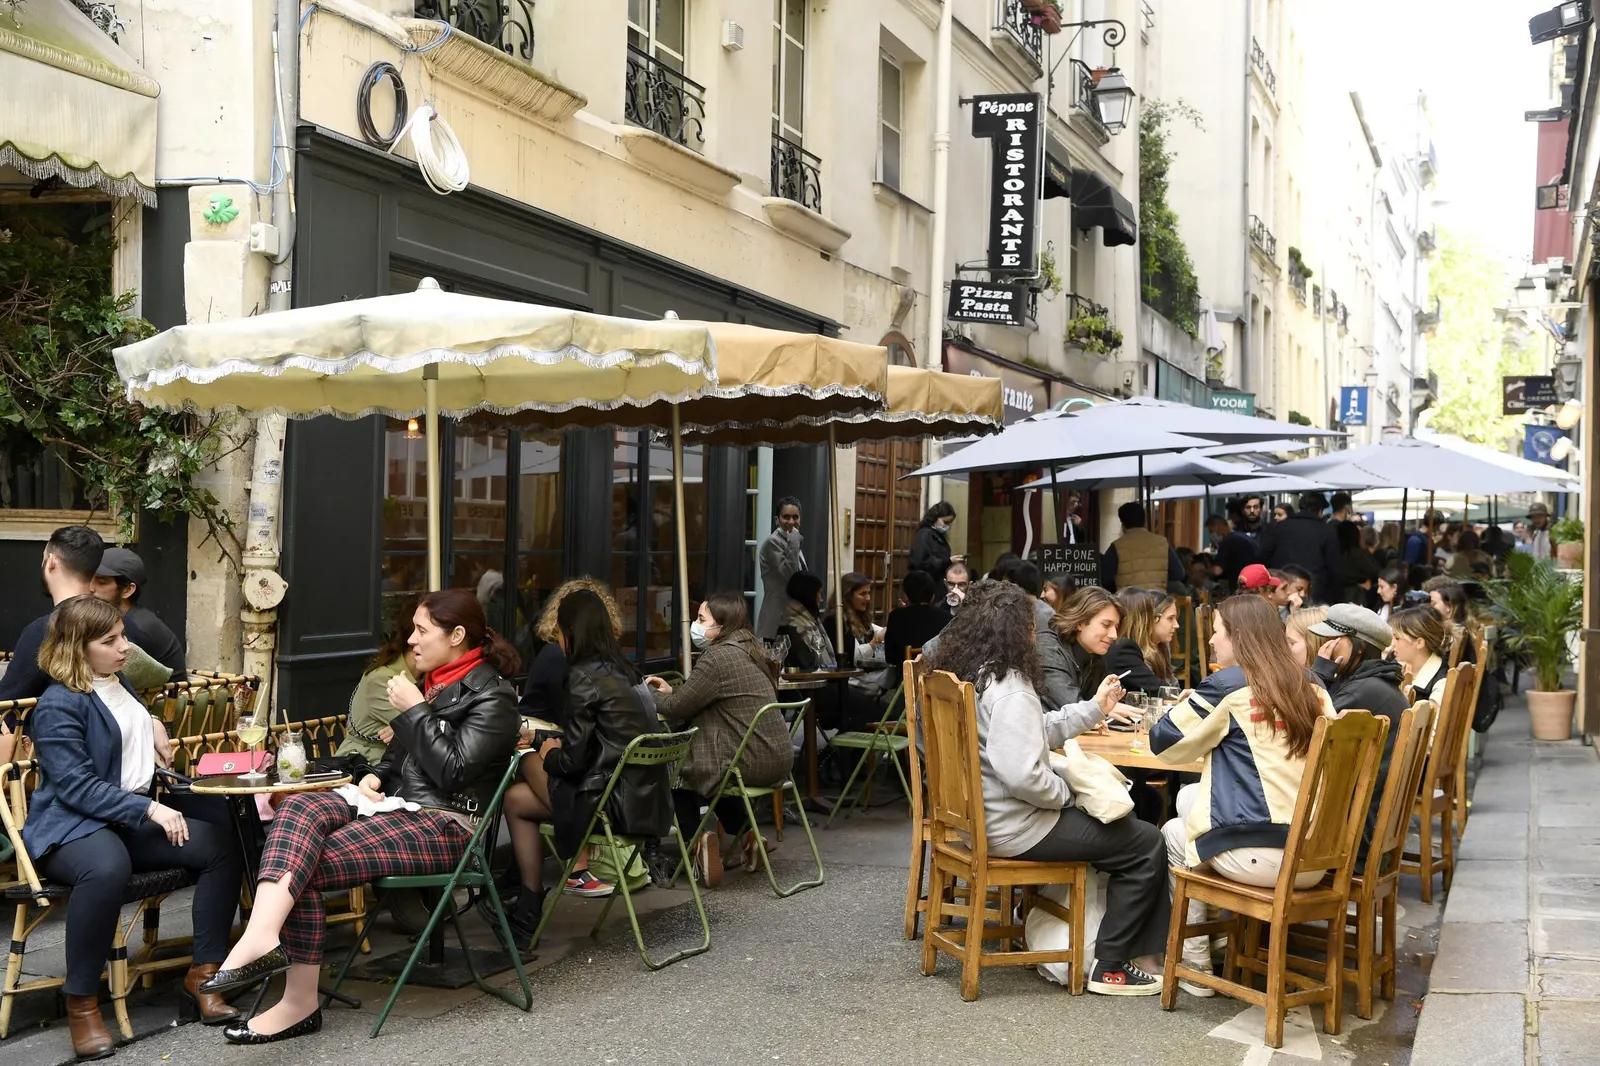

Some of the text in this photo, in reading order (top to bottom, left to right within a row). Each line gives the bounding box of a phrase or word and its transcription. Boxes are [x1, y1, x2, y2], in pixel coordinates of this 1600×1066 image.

[978, 101, 1034, 116] Pépone
[1000, 118, 1028, 267] RISTORANTE
[960, 285, 1013, 300] Pizza
[960, 298, 1010, 312] Pasta
[962, 310, 1013, 320] EMPORTER
[1212, 396, 1248, 409] YOOM
[1044, 549, 1095, 560] PEPONE
[1044, 562, 1097, 573] HAPPY HOUR
[1074, 578, 1098, 586] BIERE
